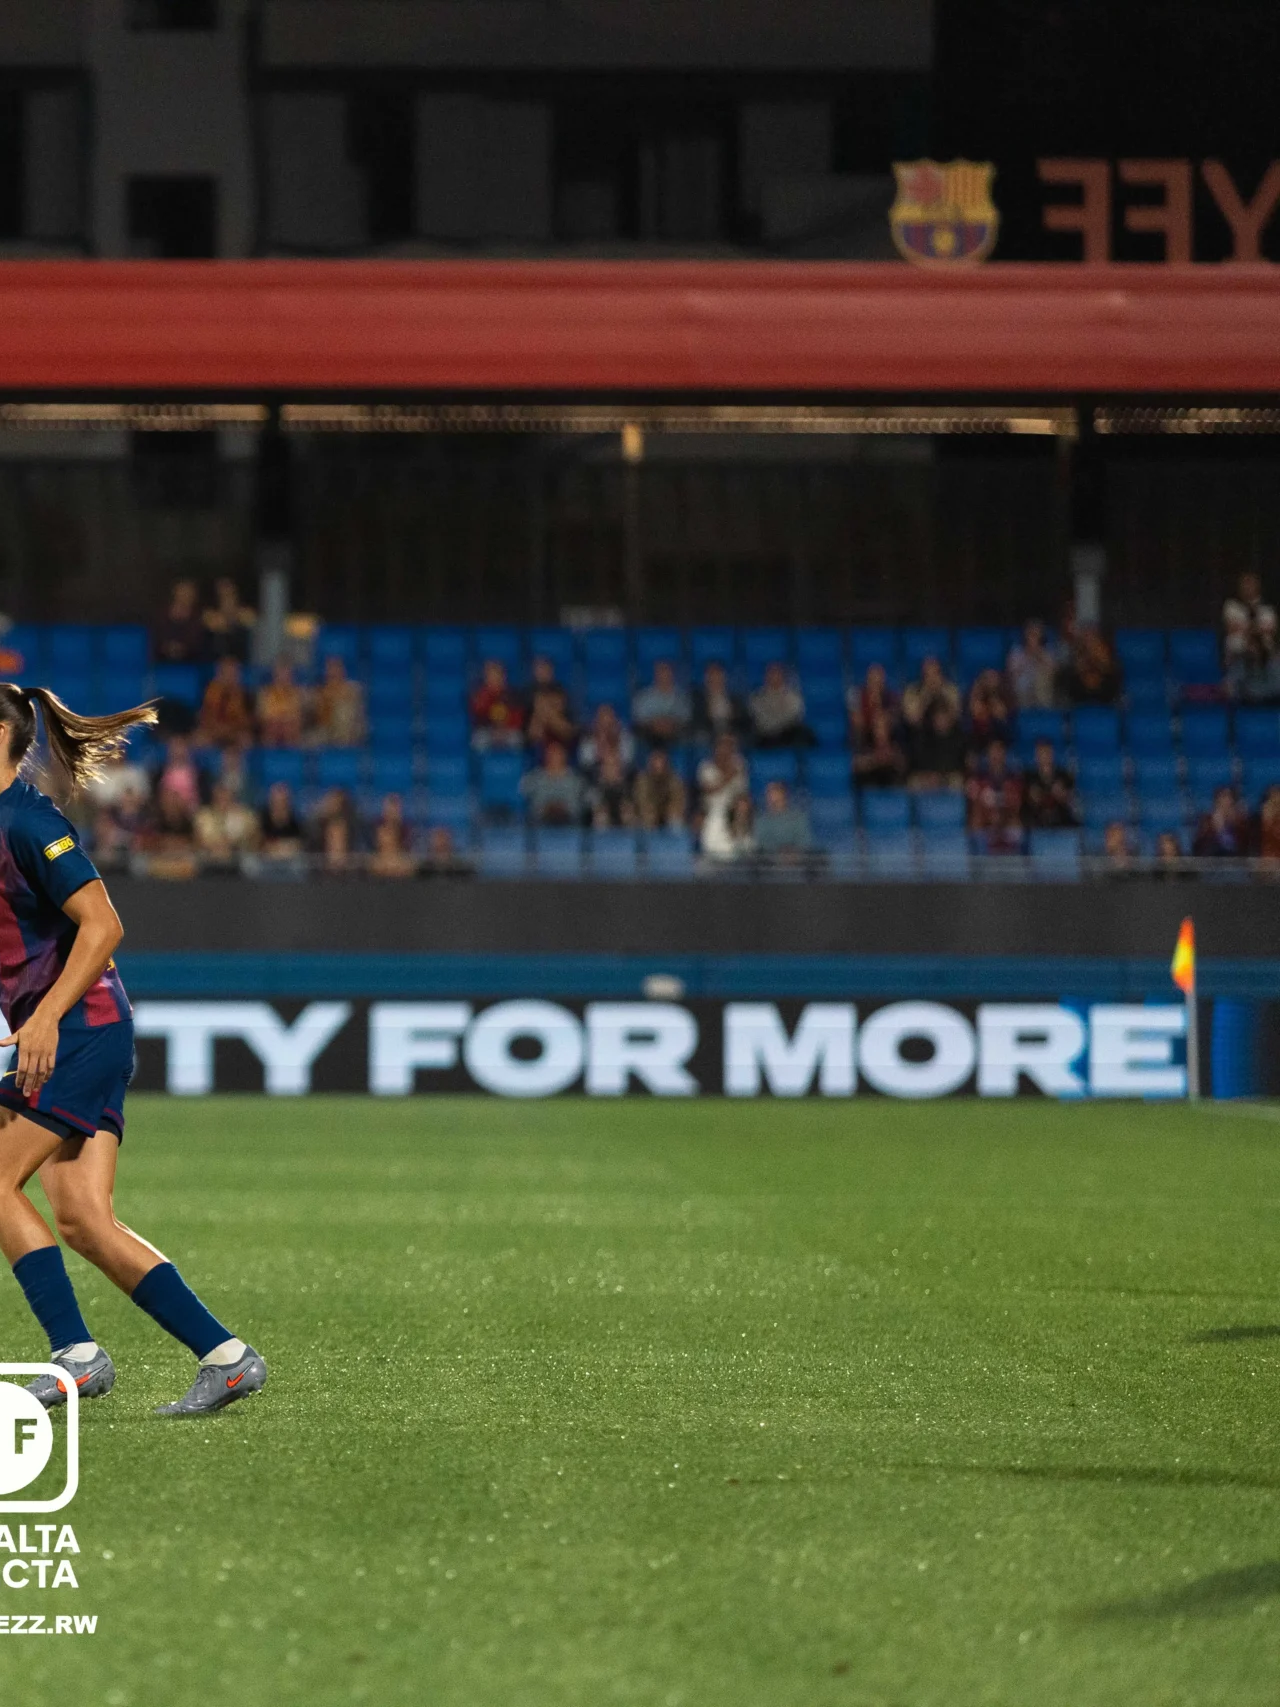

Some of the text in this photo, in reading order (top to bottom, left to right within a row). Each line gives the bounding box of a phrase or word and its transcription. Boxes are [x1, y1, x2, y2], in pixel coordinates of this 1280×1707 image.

[45, 837, 75, 860] BIMBO
[369, 1002, 700, 1097] FOR
[724, 1002, 1187, 1098] MORE
